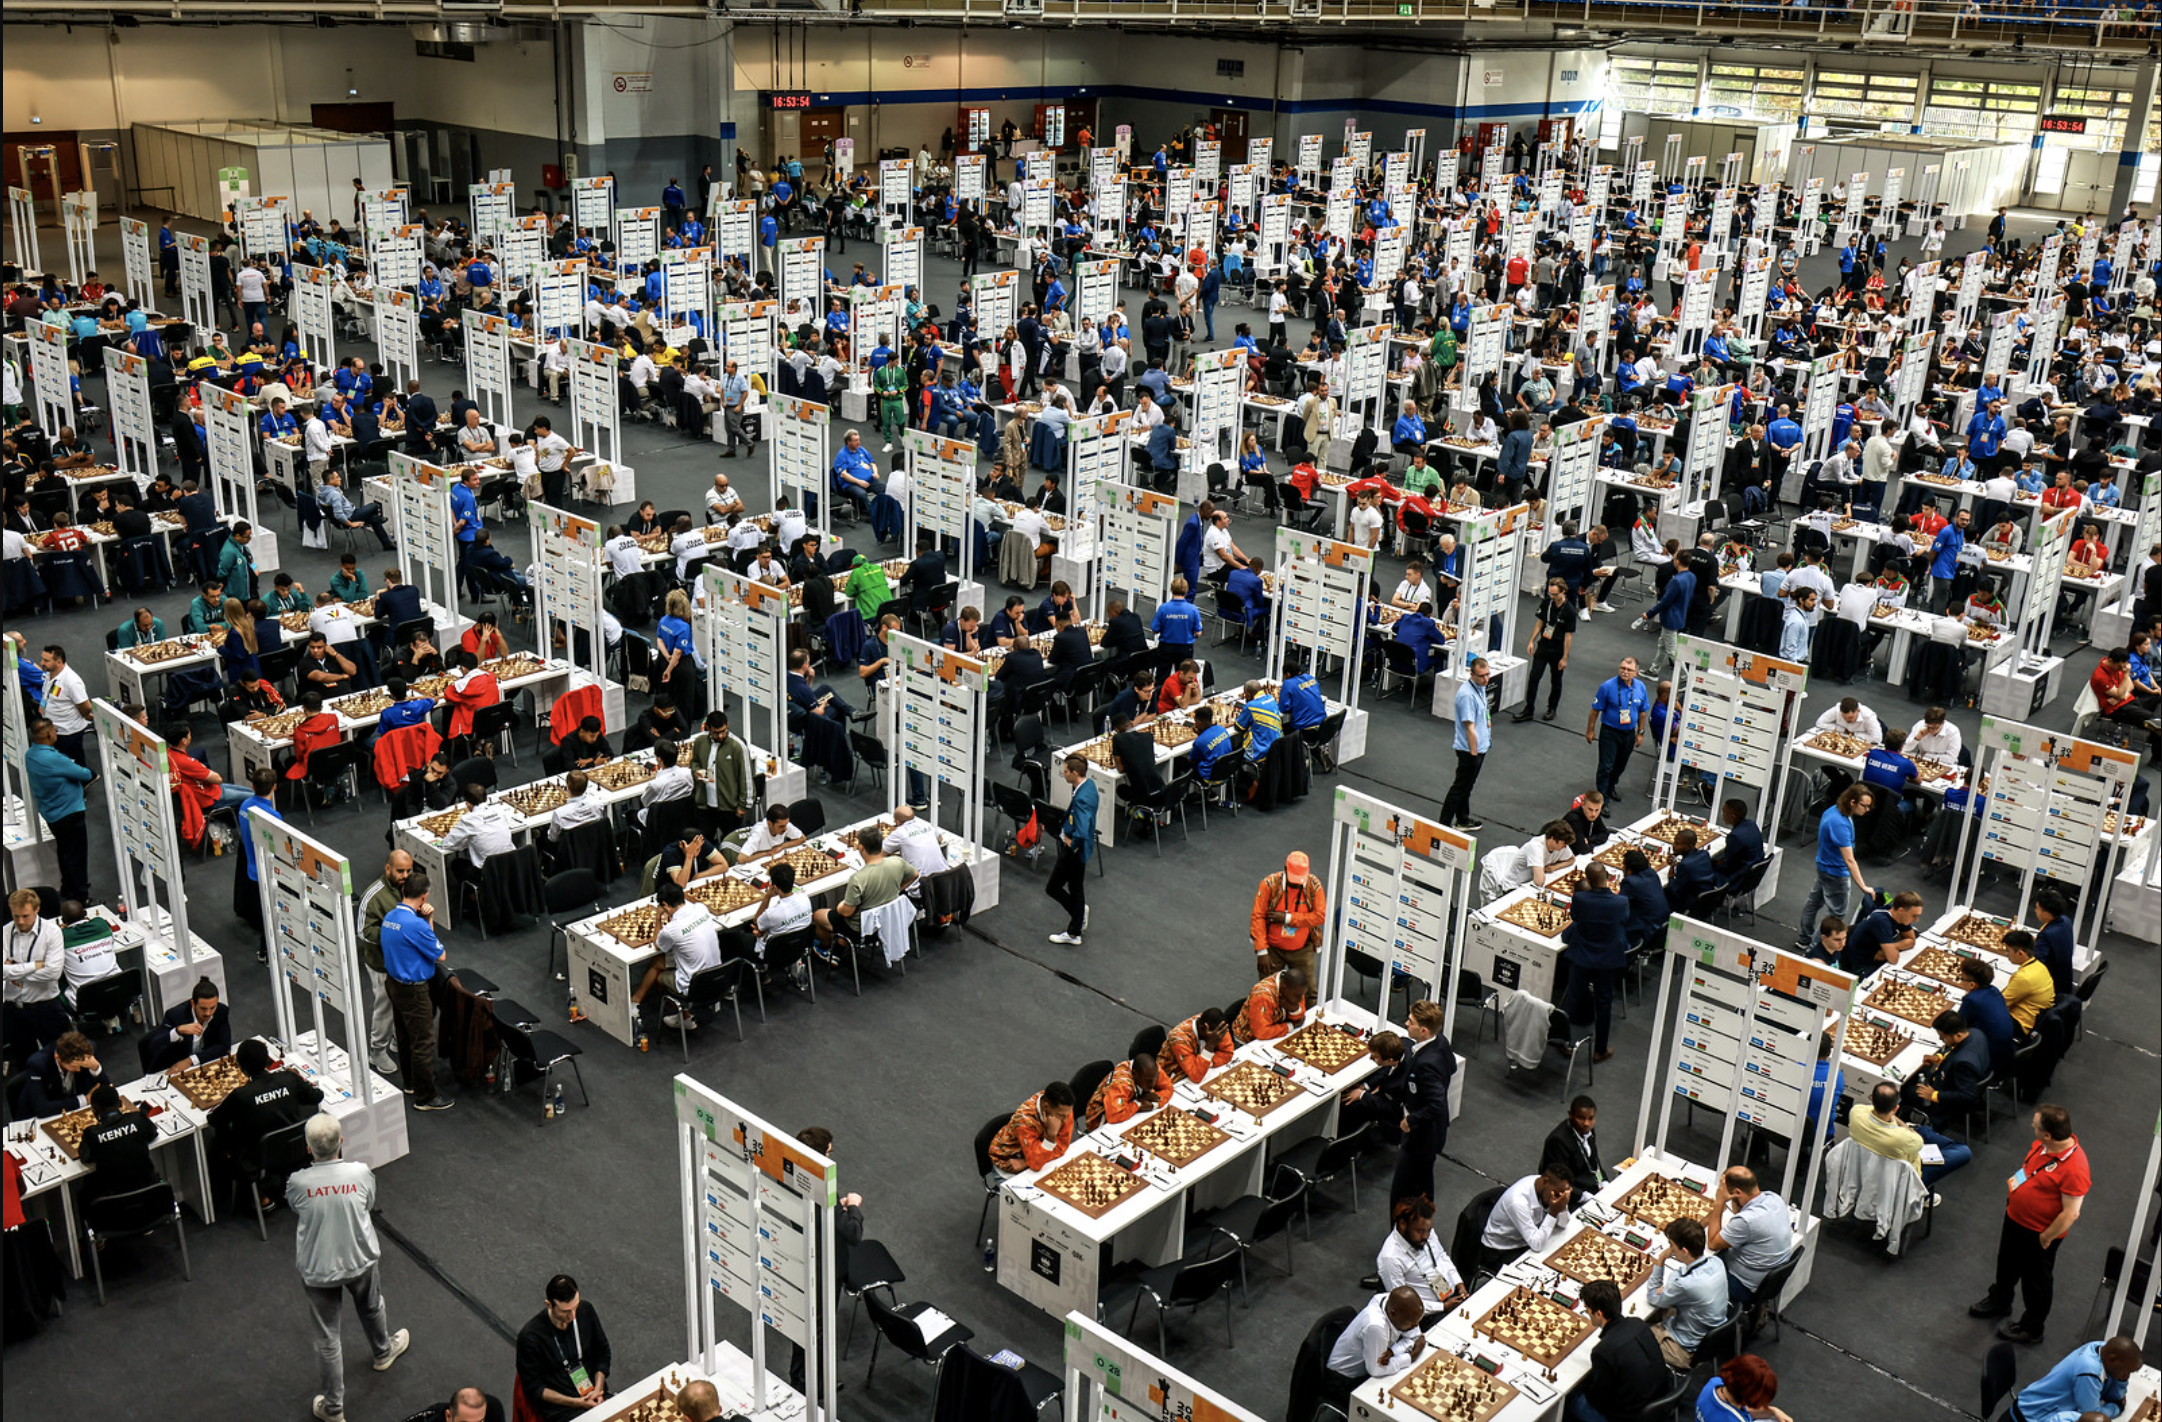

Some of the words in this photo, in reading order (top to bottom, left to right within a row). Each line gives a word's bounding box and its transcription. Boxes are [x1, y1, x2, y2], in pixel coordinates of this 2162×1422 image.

[773, 96, 811, 108] 16:53:54
[2042, 118, 2084, 132] 16:53:54
[58, 537, 79, 552] 12
[1704, 943, 1715, 952] 27
[254, 1086, 290, 1105] KENYA
[705, 1115, 715, 1125] 32
[97, 1123, 138, 1144] KENYA
[306, 1183, 357, 1198] LATVIJA
[1108, 1364, 1121, 1377] 28
